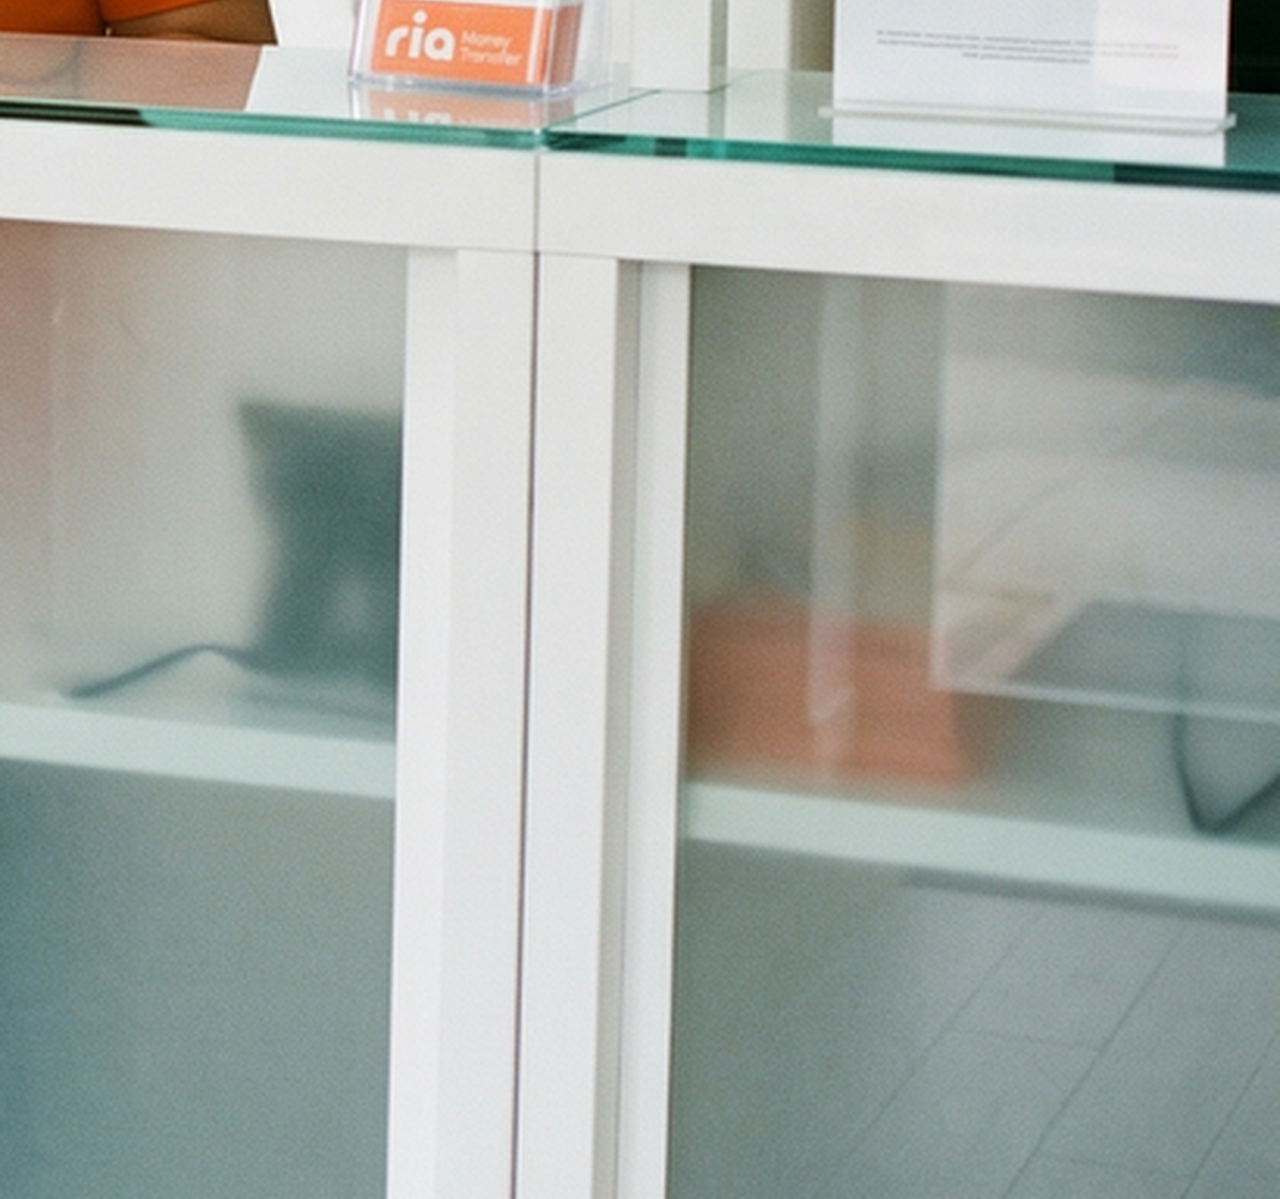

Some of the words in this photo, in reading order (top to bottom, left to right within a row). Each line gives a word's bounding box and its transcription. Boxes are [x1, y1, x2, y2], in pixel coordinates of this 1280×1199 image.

[384, 9, 455, 61] ria
[460, 30, 514, 51] Money
[459, 46, 523, 66] Transfer
